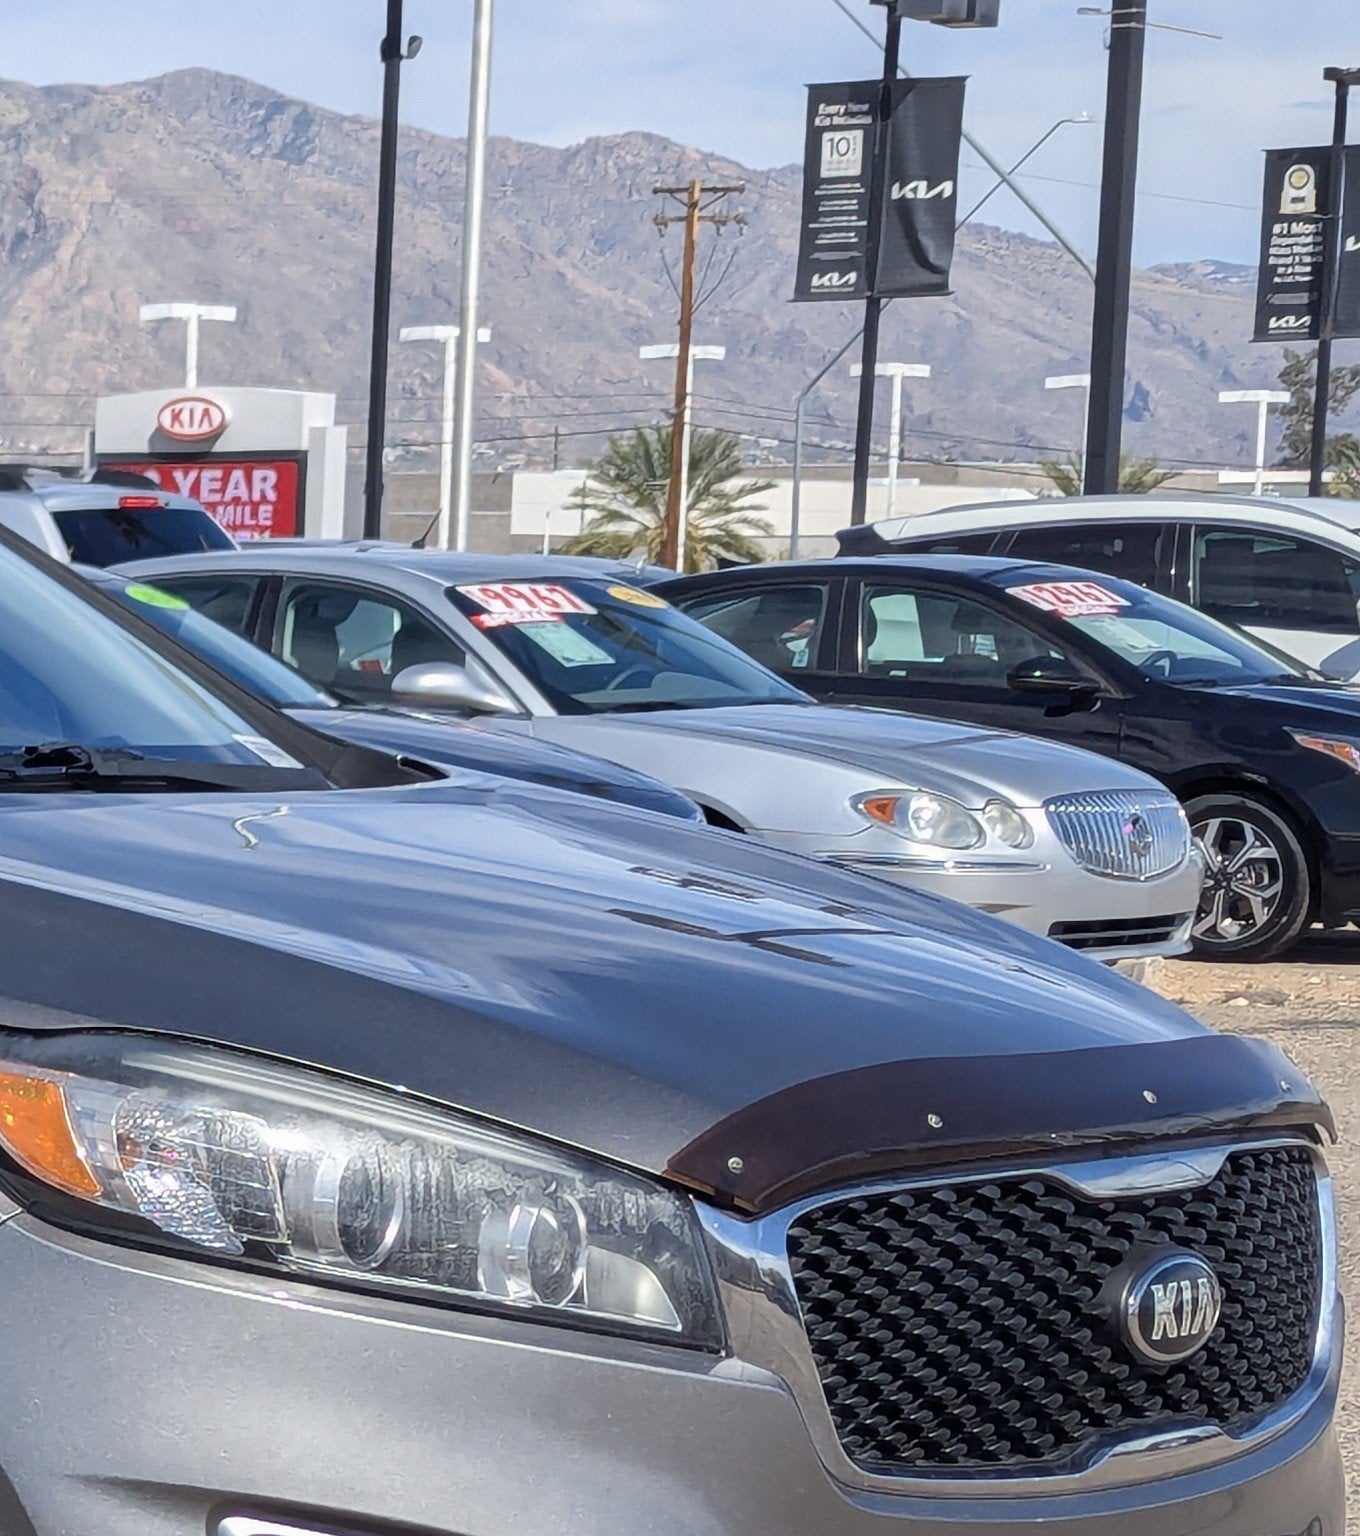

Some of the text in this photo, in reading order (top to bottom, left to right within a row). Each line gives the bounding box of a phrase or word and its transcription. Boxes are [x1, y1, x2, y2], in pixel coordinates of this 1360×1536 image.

[825, 136, 851, 159] 10
[170, 406, 213, 428] KIA
[171, 468, 279, 503] YEAR
[1150, 1278, 1217, 1340] KIA
